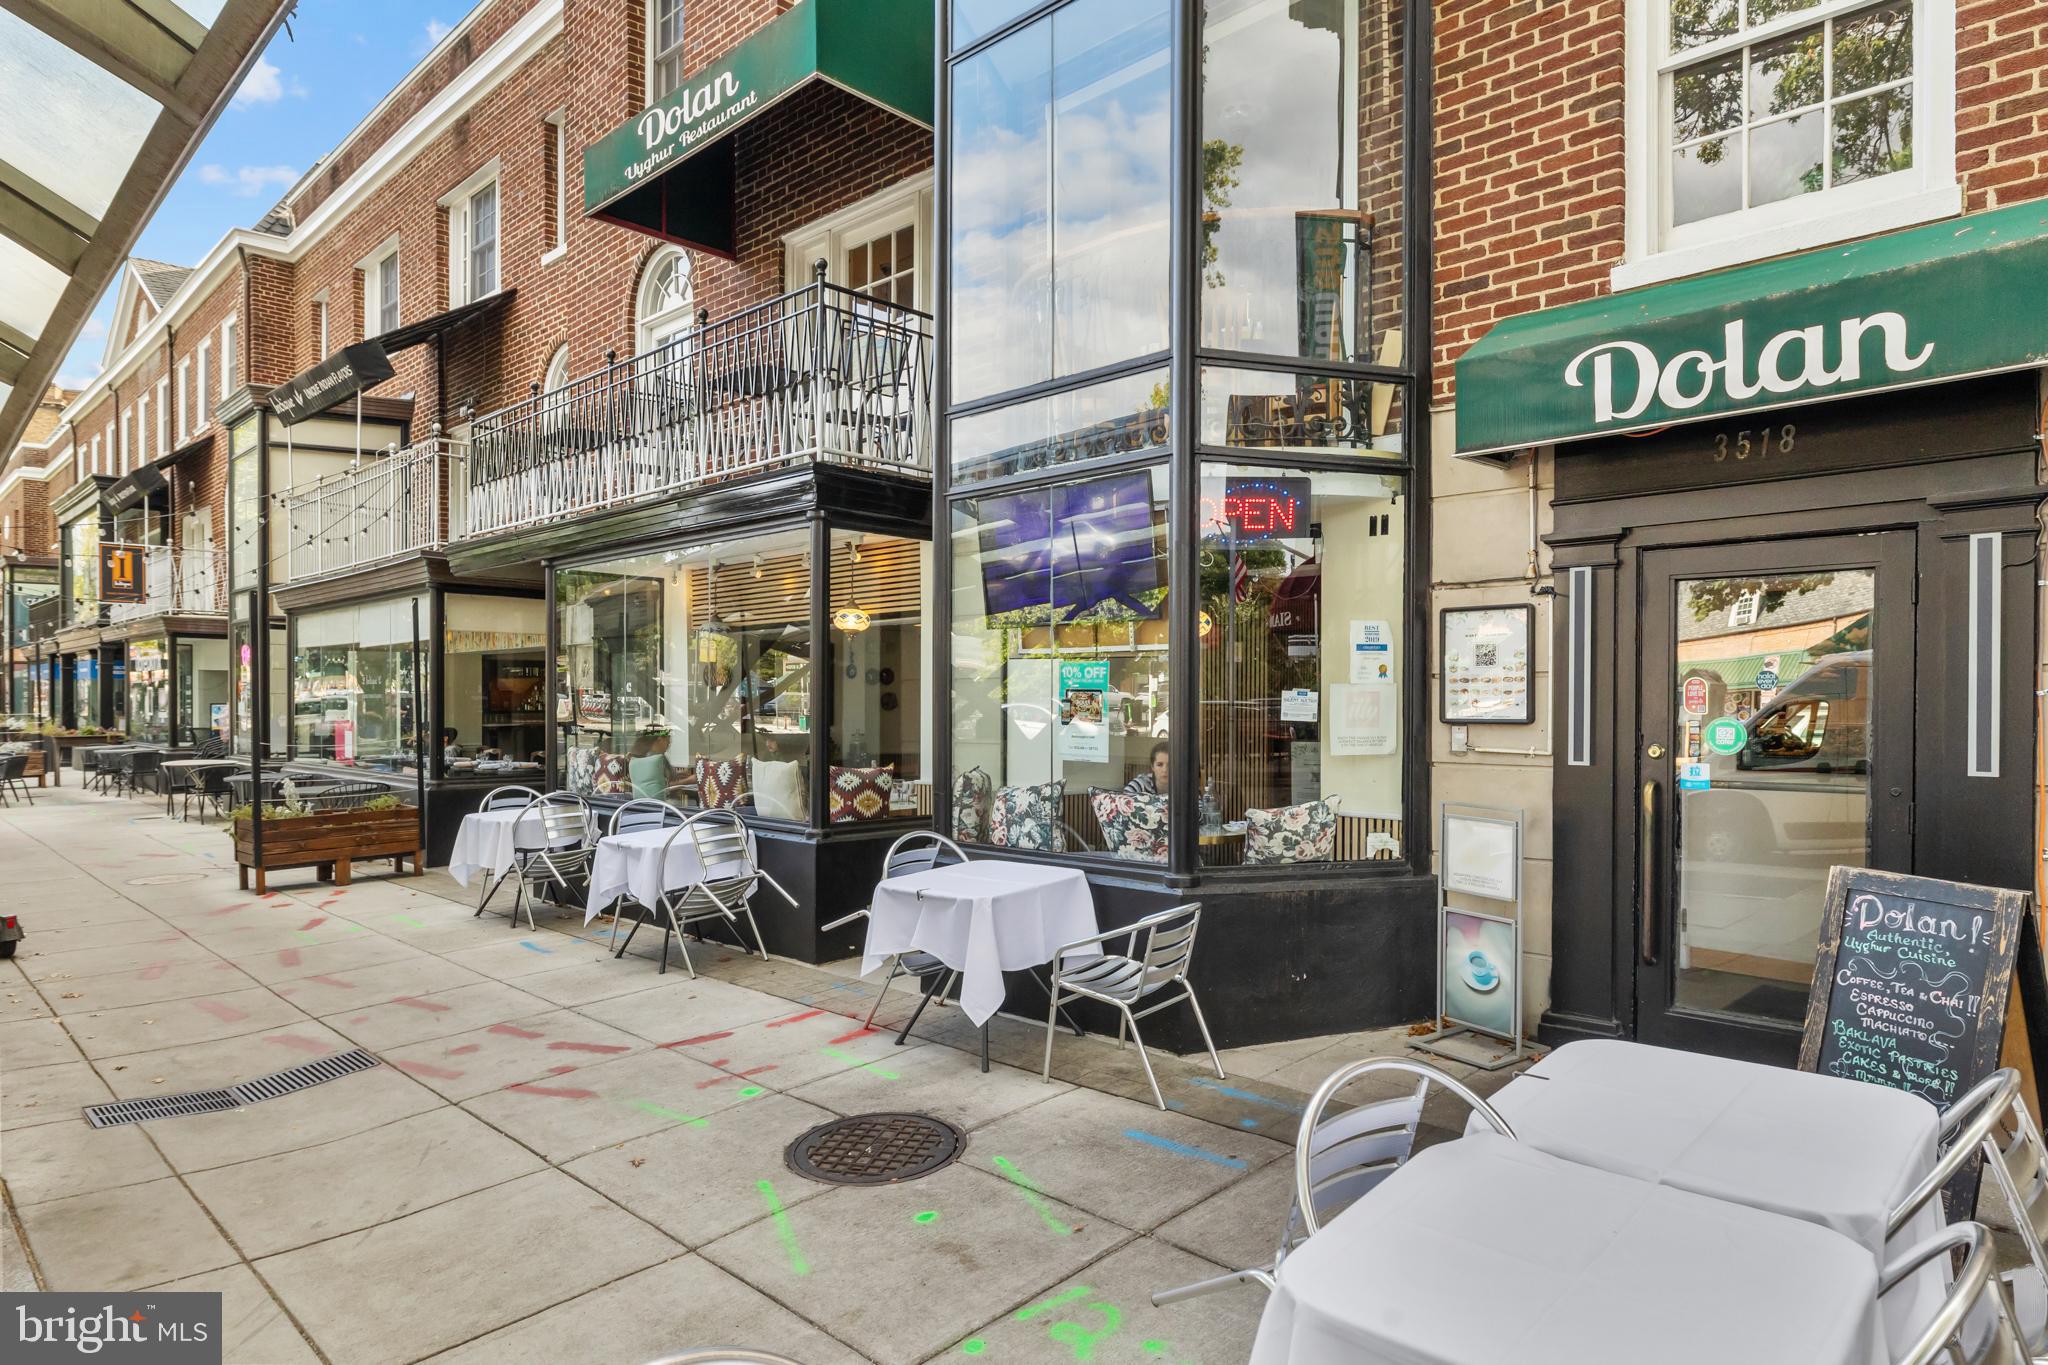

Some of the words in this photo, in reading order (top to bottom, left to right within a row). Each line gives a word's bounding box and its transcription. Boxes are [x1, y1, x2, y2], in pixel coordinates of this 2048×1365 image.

[638, 70, 739, 150] Dolan
[624, 142, 676, 181] Uyghur
[679, 90, 758, 146] Restaurant
[1564, 311, 1934, 423] Dolan
[1712, 424, 1796, 462] 3518
[1199, 496, 1295, 533] OPEN
[1061, 666, 1082, 679] 10%
[1085, 667, 1107, 679] OFF
[1844, 936, 1892, 956] Uyghur
[1897, 947, 1957, 969] Cuisine
[1849, 990, 1914, 1013] ESPRESSO
[1919, 992, 1928, 1001] &
[1856, 1002, 1935, 1030] CAPPUCCINO
[1832, 1019, 1897, 1050] BAKLAVA
[1839, 1036, 1881, 1059] EXOTIC
[1888, 1051, 1959, 1081] PASTRIES
[1842, 1051, 1888, 1075] CAKES
